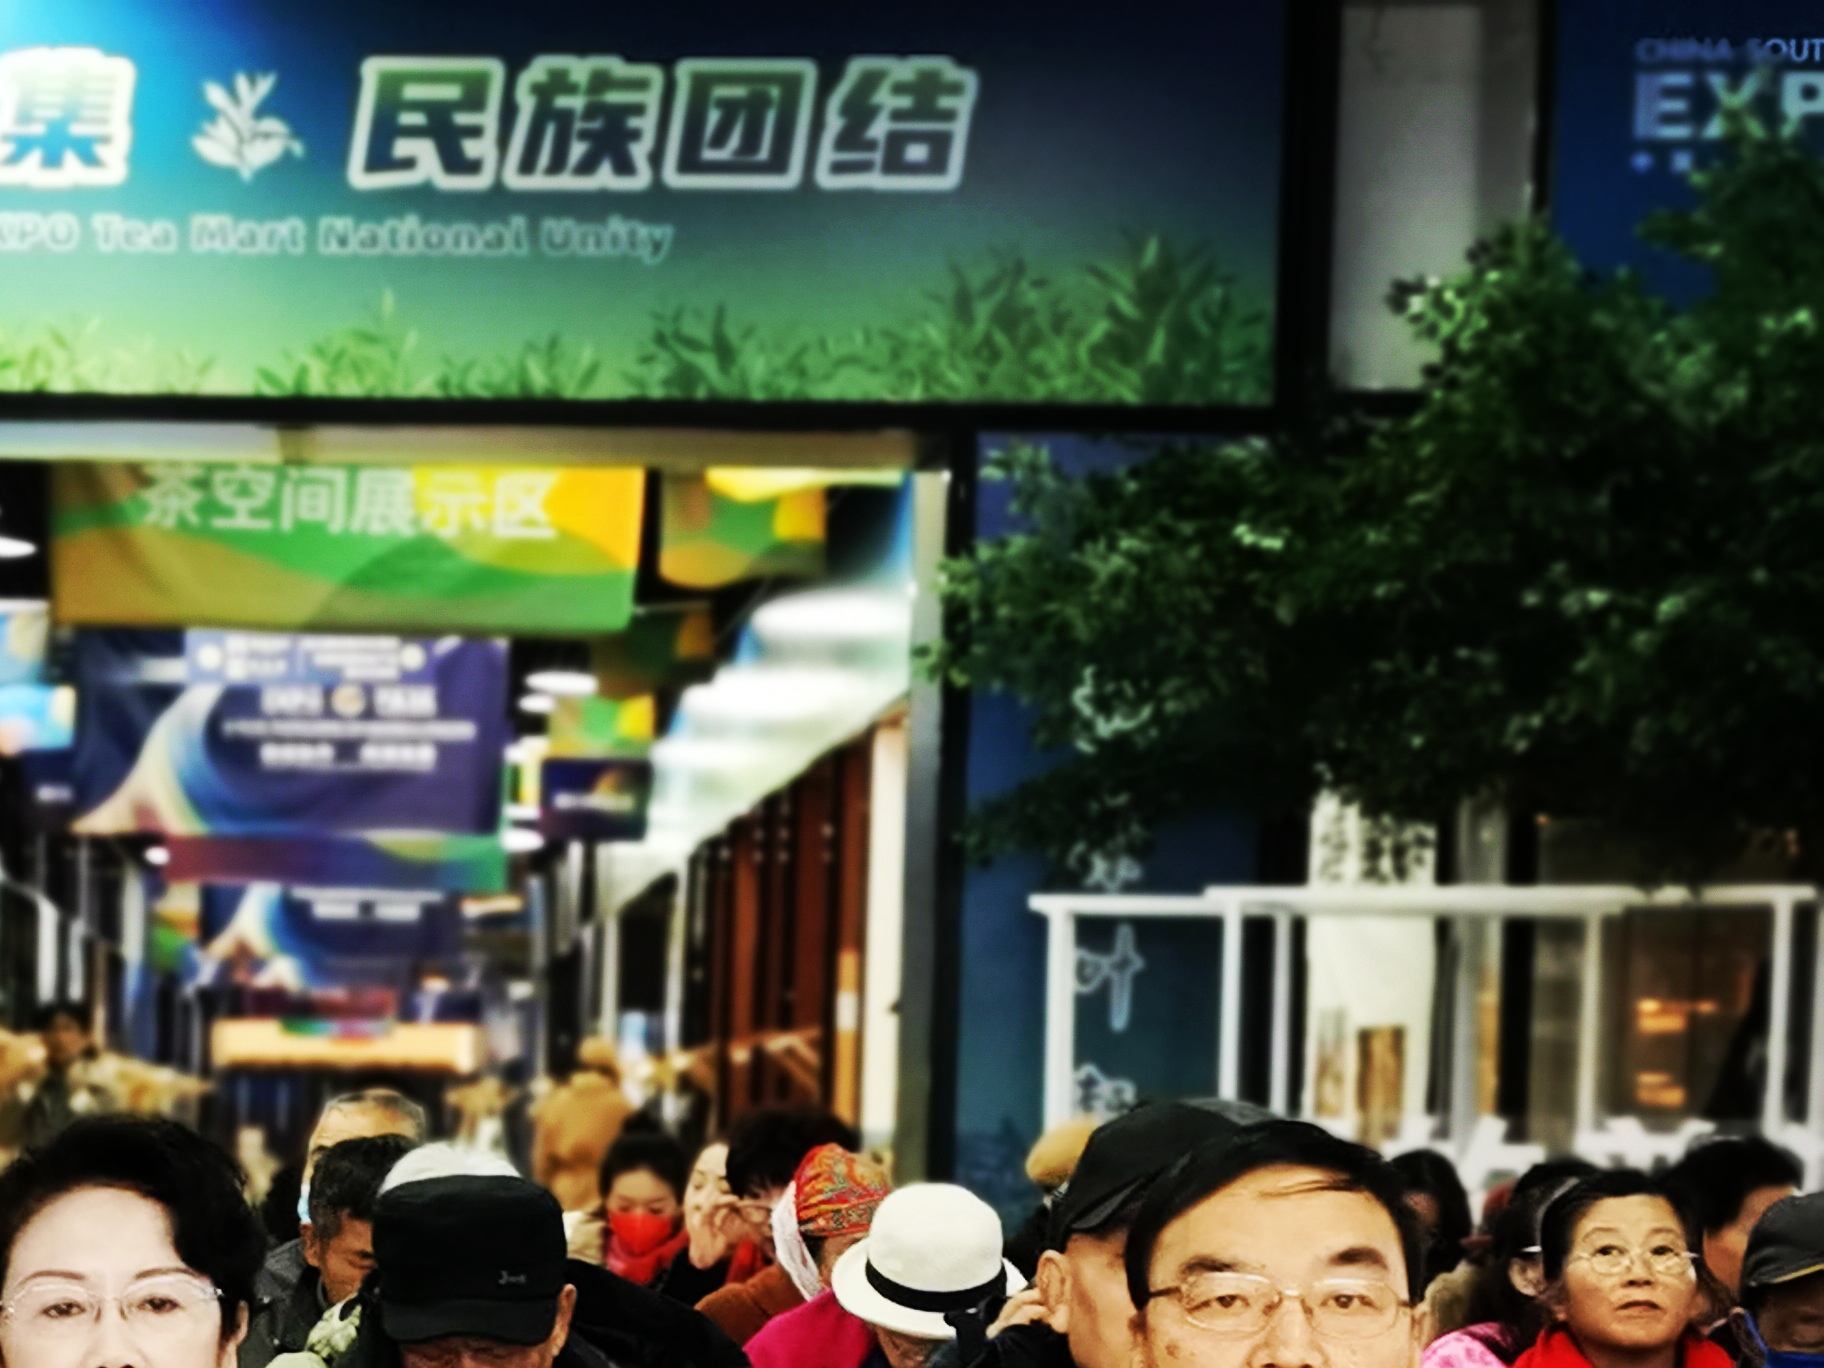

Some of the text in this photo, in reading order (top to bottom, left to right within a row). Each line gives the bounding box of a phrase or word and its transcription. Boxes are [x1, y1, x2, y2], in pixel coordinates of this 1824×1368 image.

[347, 54, 978, 191] 民族团结
[91, 213, 177, 252] Tea
[190, 214, 306, 254] Mart
[318, 214, 527, 256] National
[541, 216, 676, 263] Unity
[143, 463, 560, 539] 茶空间展示区
